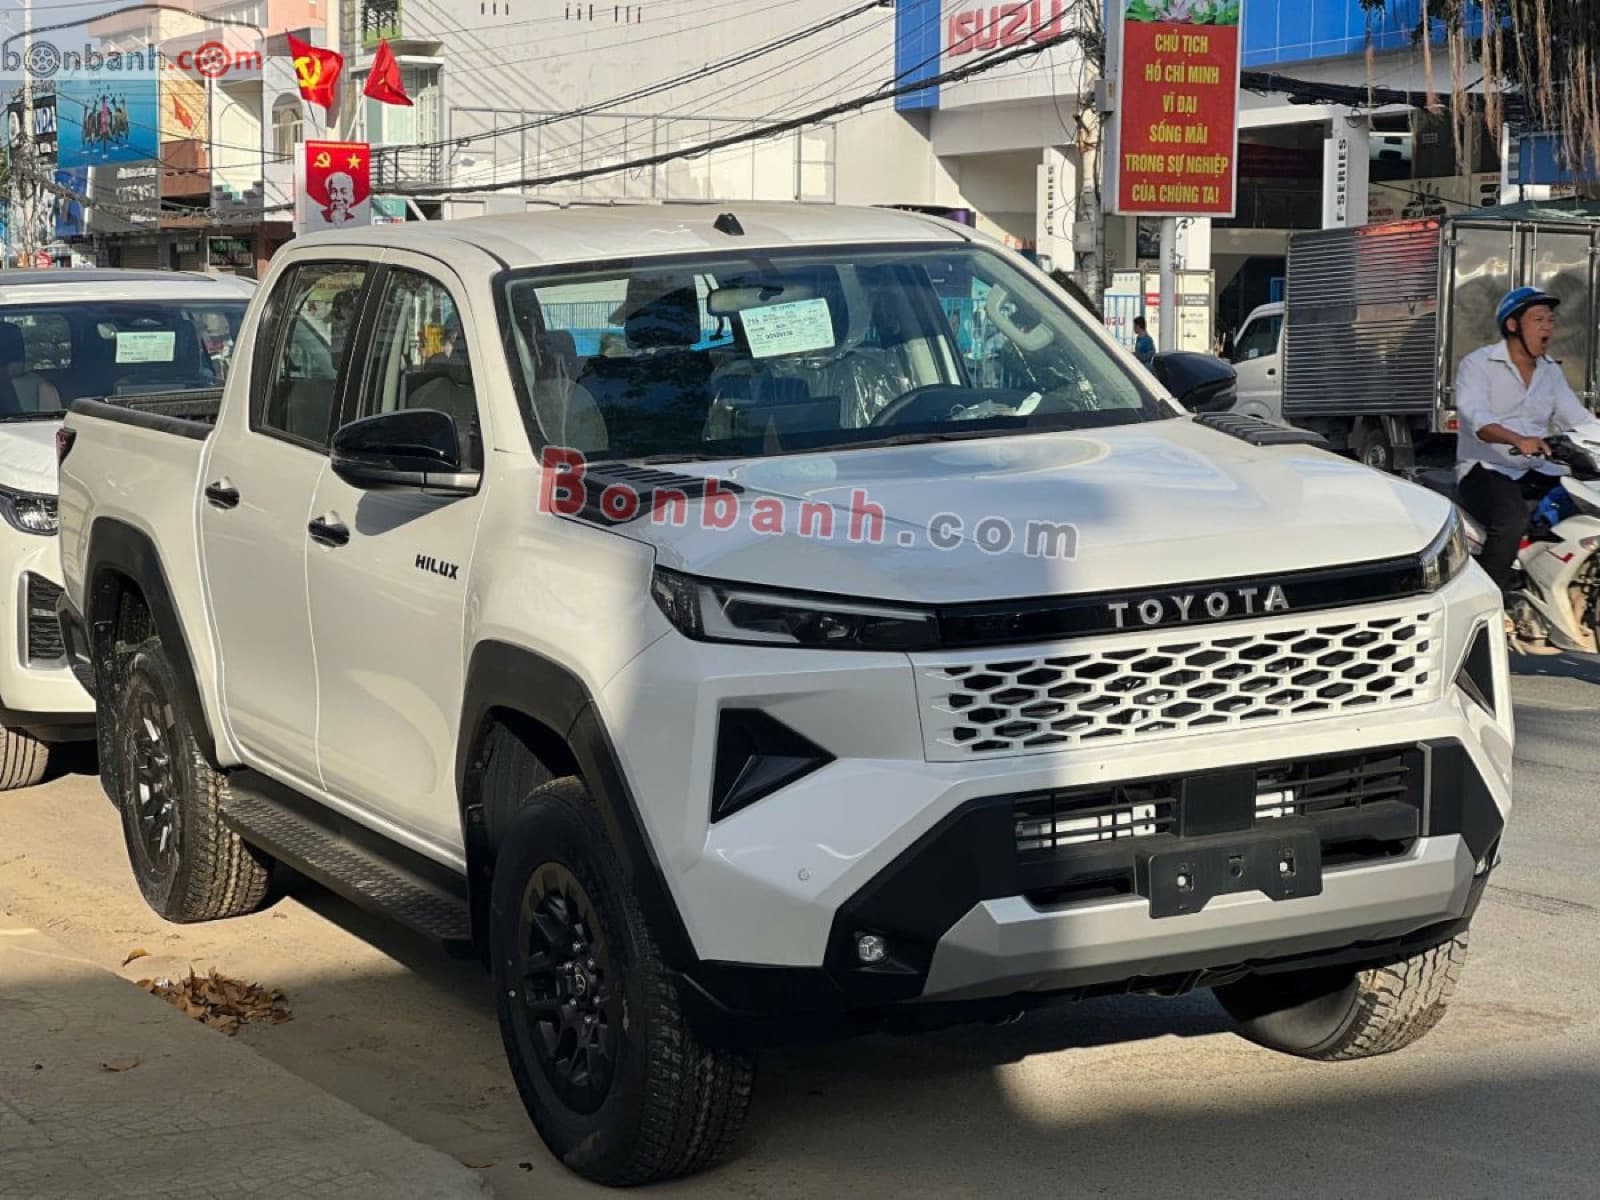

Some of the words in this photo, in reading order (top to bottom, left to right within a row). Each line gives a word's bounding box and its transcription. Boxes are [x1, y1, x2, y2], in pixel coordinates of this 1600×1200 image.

[948, 0, 1062, 57] ISUZU
[1155, 28, 1179, 52] CHỦ
[1182, 35, 1208, 56] TỊCH
[1165, 61, 1185, 82] CHÍ
[1188, 66, 1219, 84] MINH
[1149, 118, 1182, 143] SỐNG
[1185, 122, 1208, 144] MÃI
[1125, 154, 1164, 172] TRONG
[1167, 154, 1184, 177] SỰ
[1186, 153, 1229, 178] NGHIỆP
[1132, 178, 1155, 203] CỦA
[1160, 181, 1198, 204] CHÚNG
[1202, 186, 1219, 205] TA!
[415, 554, 460, 581] HILUX
[1108, 584, 1290, 629] TOYOTA
